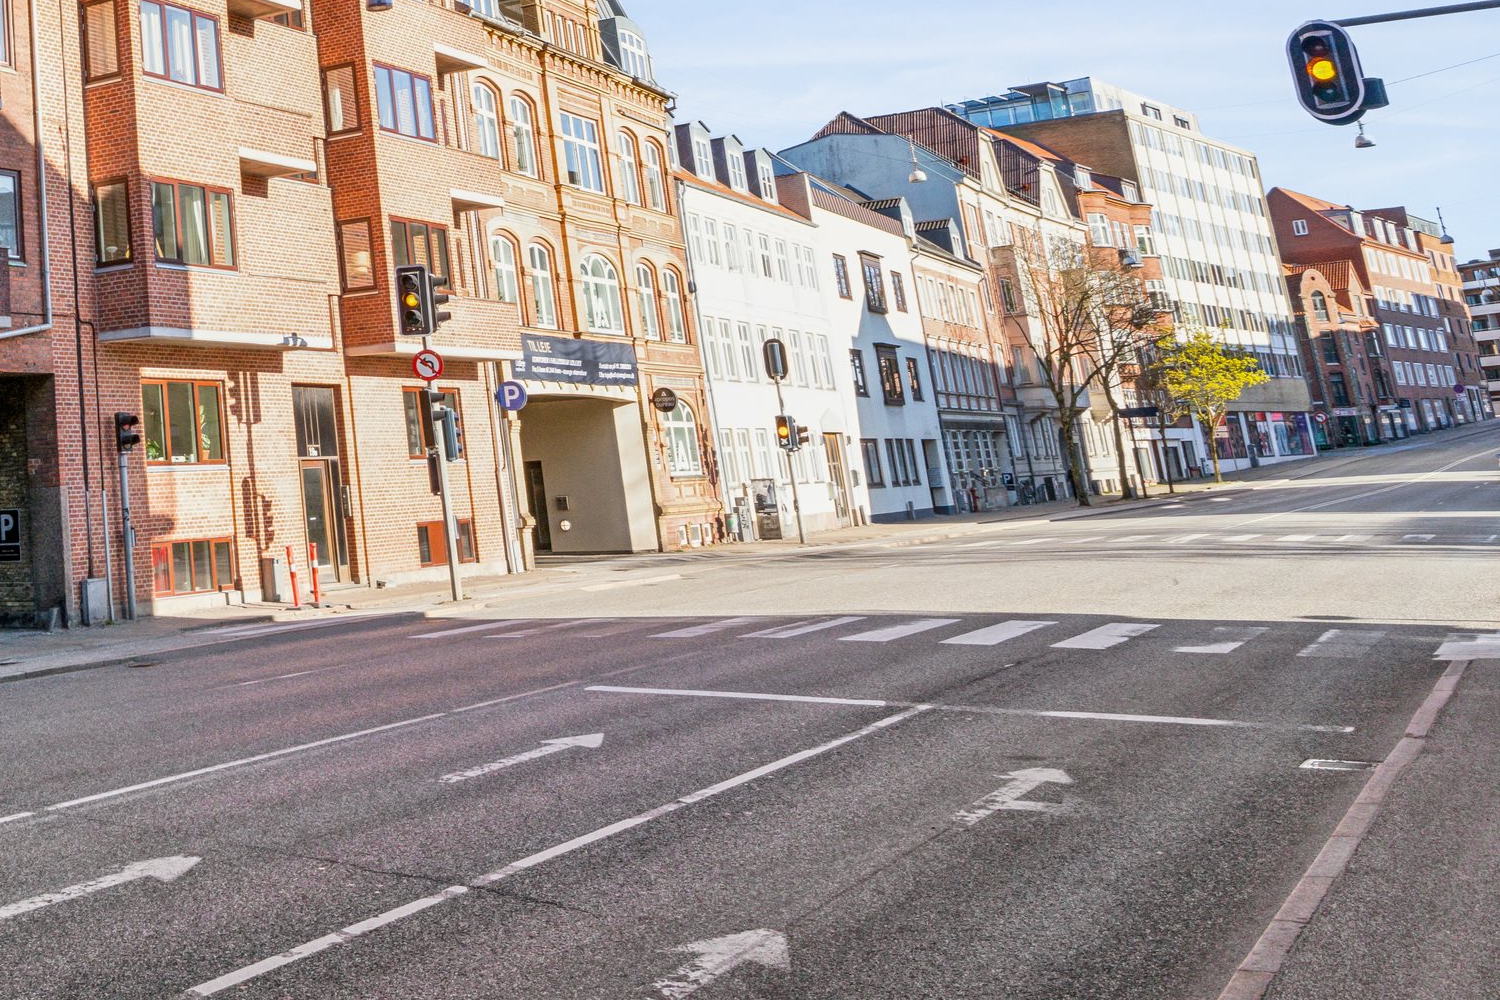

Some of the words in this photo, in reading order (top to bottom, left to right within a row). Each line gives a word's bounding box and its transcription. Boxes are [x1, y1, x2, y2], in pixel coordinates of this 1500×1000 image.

[503, 385, 520, 408] P
[1003, 474, 1011, 484] P
[0, 514, 14, 541] P
